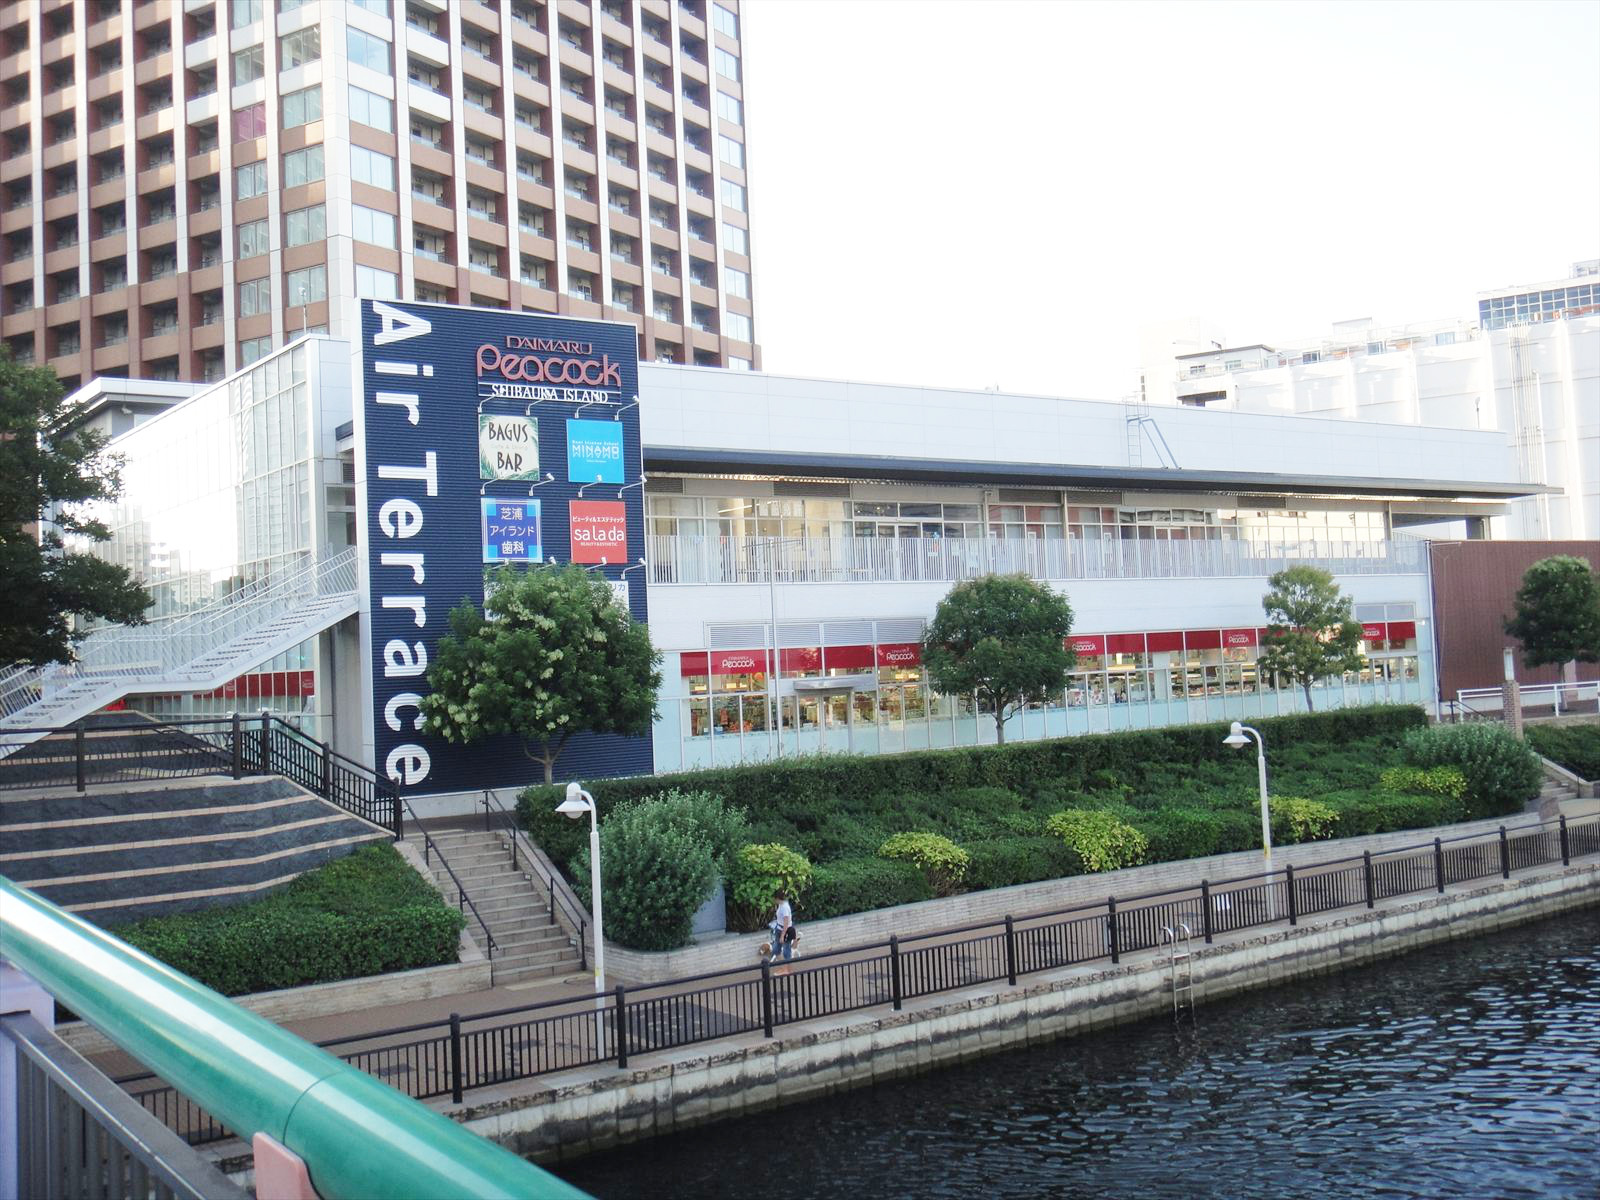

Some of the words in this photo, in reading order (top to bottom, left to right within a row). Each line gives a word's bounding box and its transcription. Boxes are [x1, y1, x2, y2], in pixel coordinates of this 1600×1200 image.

[506, 335, 593, 355] DAIMARU
[373, 300, 434, 426] Air
[476, 344, 622, 387] Peacock
[491, 383, 558, 401] SHIBAURA
[563, 389, 609, 404] ISLAND
[488, 421, 529, 443] BAGUS
[497, 451, 523, 473] BAR
[500, 506, 523, 521] 芝浦
[489, 525, 535, 537] アイランド
[501, 541, 525, 555] 歯科
[378, 451, 438, 786] Terrace
